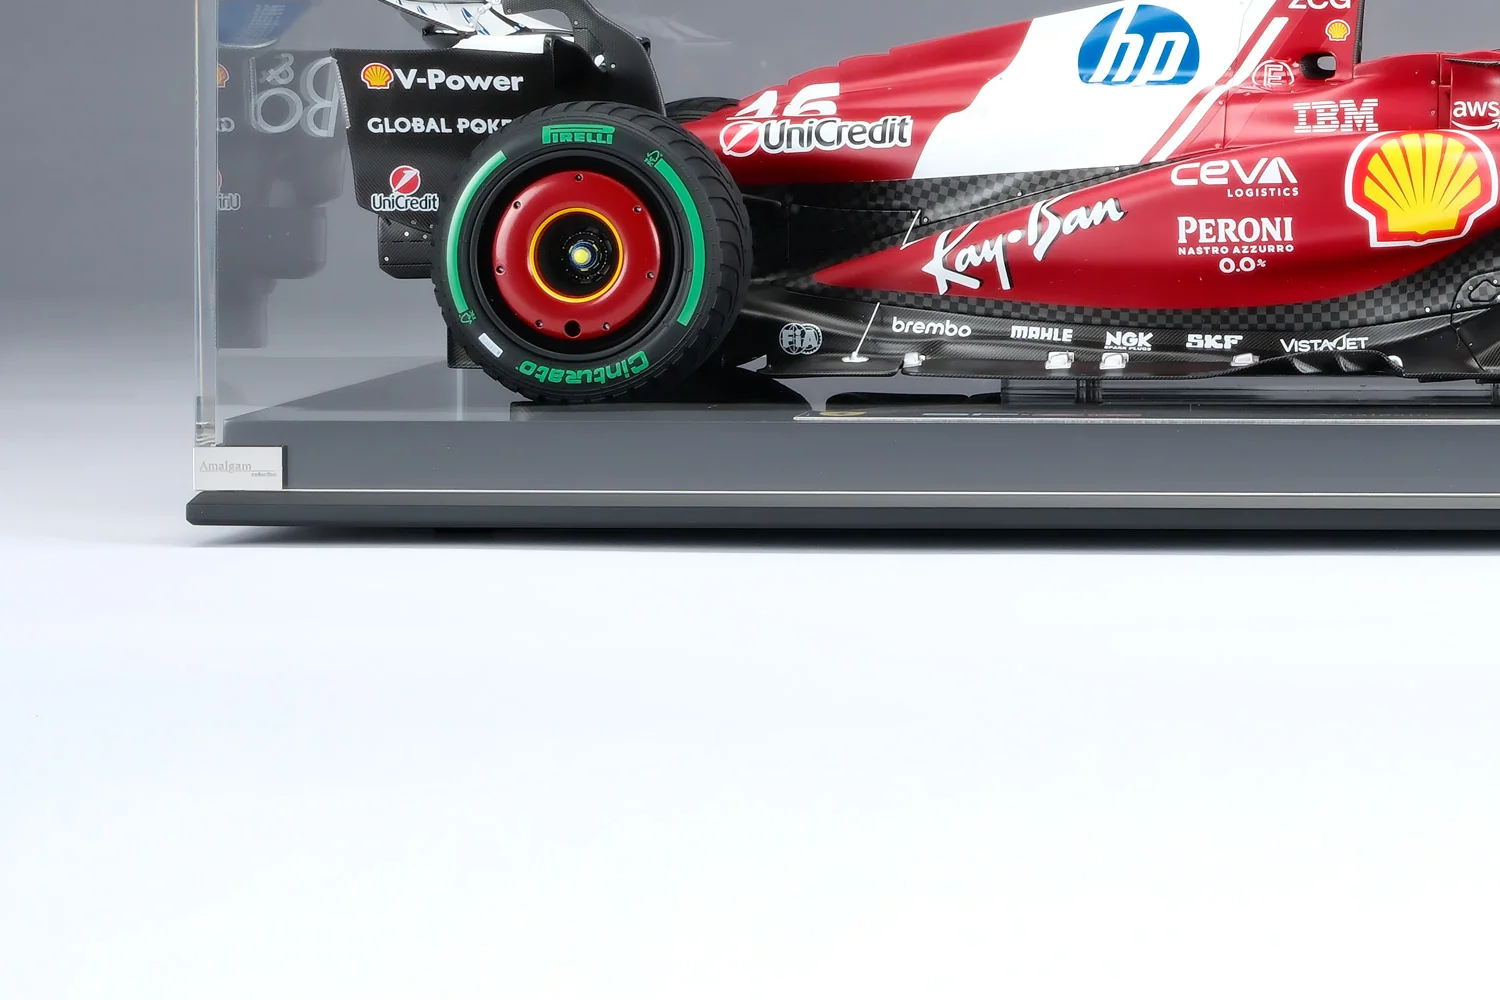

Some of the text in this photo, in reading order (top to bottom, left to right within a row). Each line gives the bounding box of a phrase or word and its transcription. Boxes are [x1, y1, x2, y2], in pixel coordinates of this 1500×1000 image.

[1094, 6, 1191, 86] hp
[394, 68, 524, 92] V-Power
[1293, 98, 1379, 133] IBM
[1453, 100, 1500, 118] aws
[367, 117, 453, 134] GLOBAL
[542, 123, 615, 145] PIRELLI
[764, 117, 910, 151] UniCredit
[1227, 187, 1299, 197] LOGISTICS
[371, 193, 440, 212] UniCredit
[1177, 216, 1294, 244] PERONI
[1178, 244, 1295, 255] NASTRO AZZURRO
[891, 316, 972, 338] brembo
[1010, 325, 1074, 342] MAHLE
[1106, 331, 1154, 347] NGK
[1186, 333, 1243, 349] SKF
[518, 350, 650, 384] Cinturato
[199, 460, 252, 473] Amalgam
